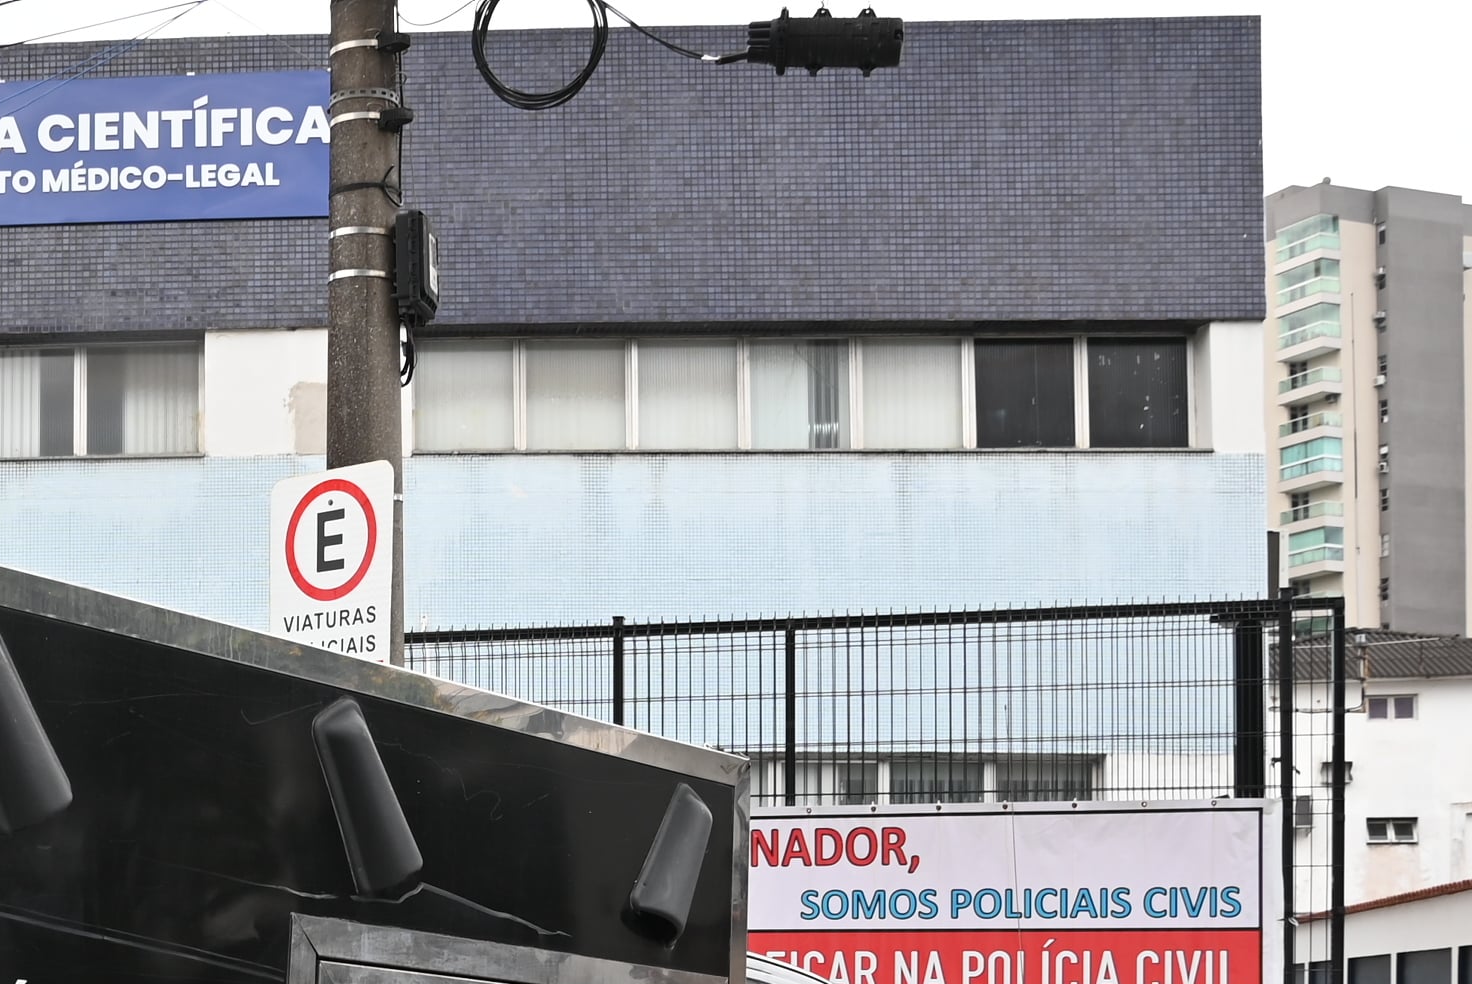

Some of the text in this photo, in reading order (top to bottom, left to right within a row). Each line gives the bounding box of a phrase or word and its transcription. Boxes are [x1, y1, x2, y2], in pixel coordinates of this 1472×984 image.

[36, 95, 330, 151] CIENTÍFICA
[42, 160, 280, 193] MÉDICO-LEGAL
[316, 508, 345, 573] E
[283, 605, 376, 633] VIATURAS
[750, 826, 920, 874] NADOR,
[800, 886, 1242, 920] SOMOS POLICIAIS CIVIS
